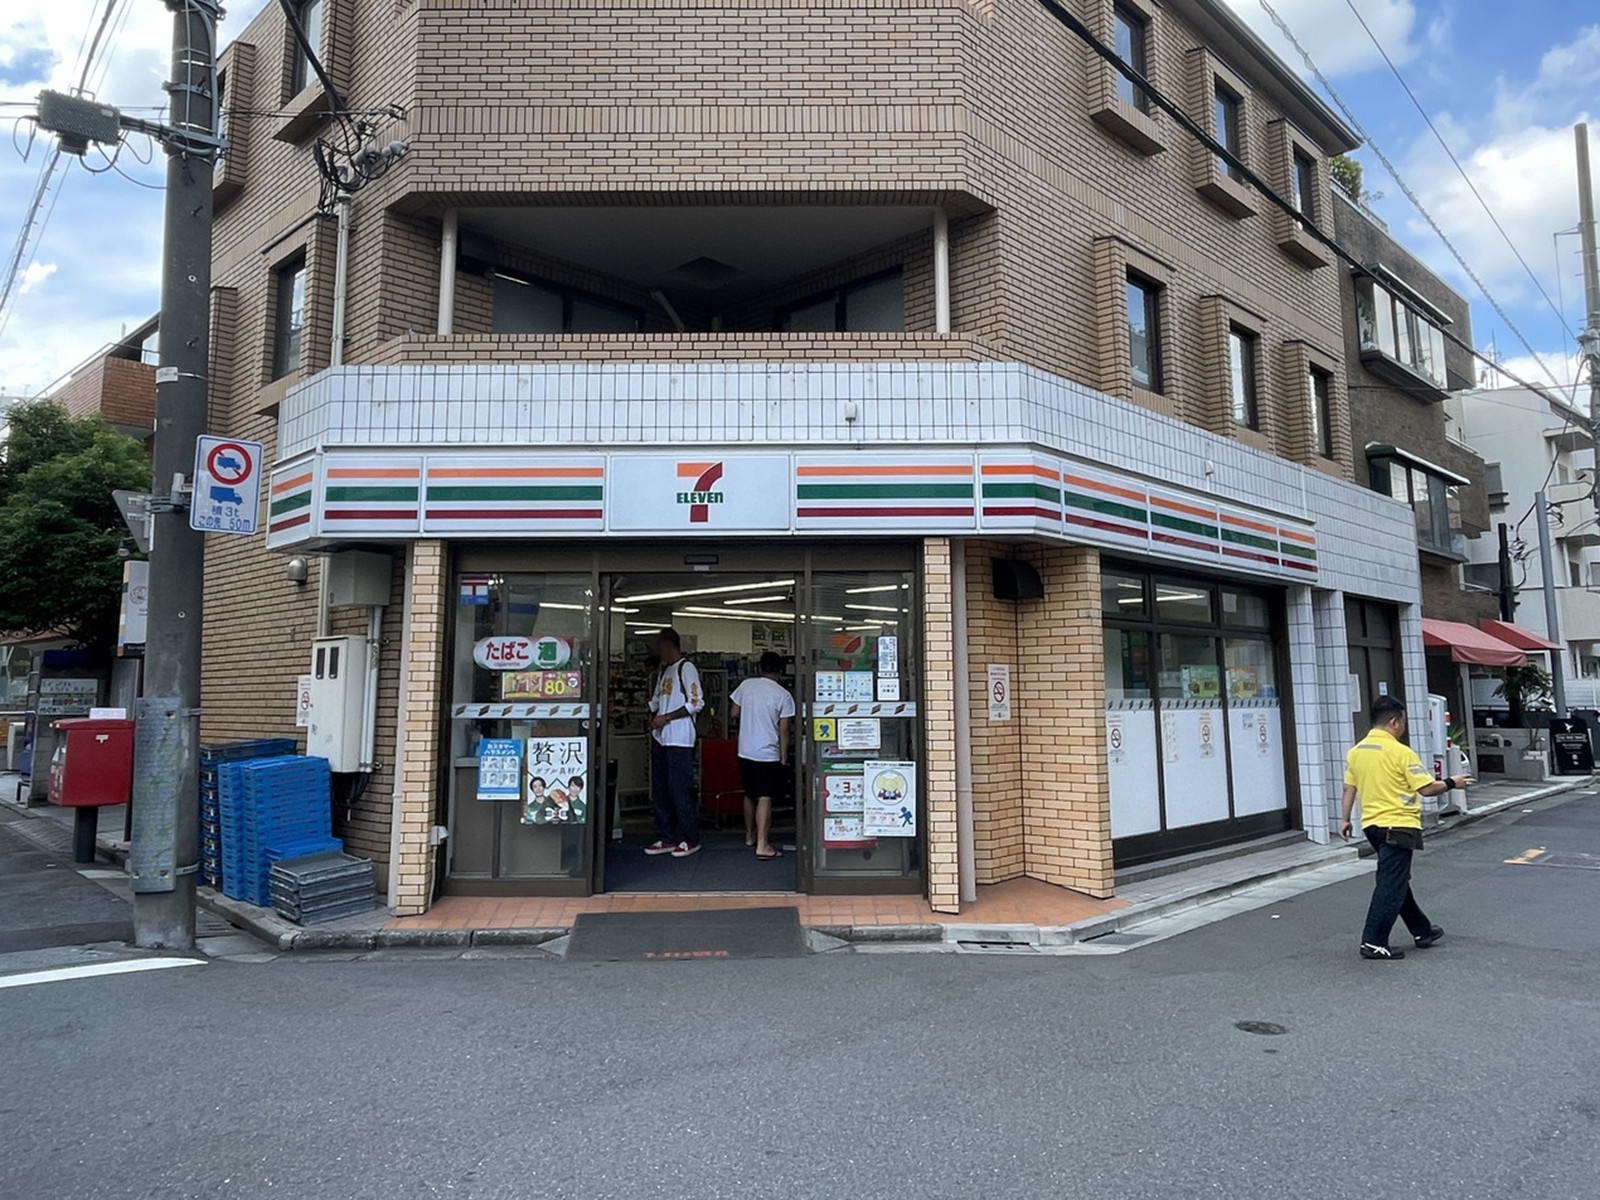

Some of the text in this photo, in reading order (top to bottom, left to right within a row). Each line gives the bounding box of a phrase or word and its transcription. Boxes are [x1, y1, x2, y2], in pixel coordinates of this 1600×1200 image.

[677, 461, 723, 523] 7
[229, 518, 251, 530] 50m
[486, 640, 557, 661] たばこ 酒
[533, 741, 583, 766] 贅沢
